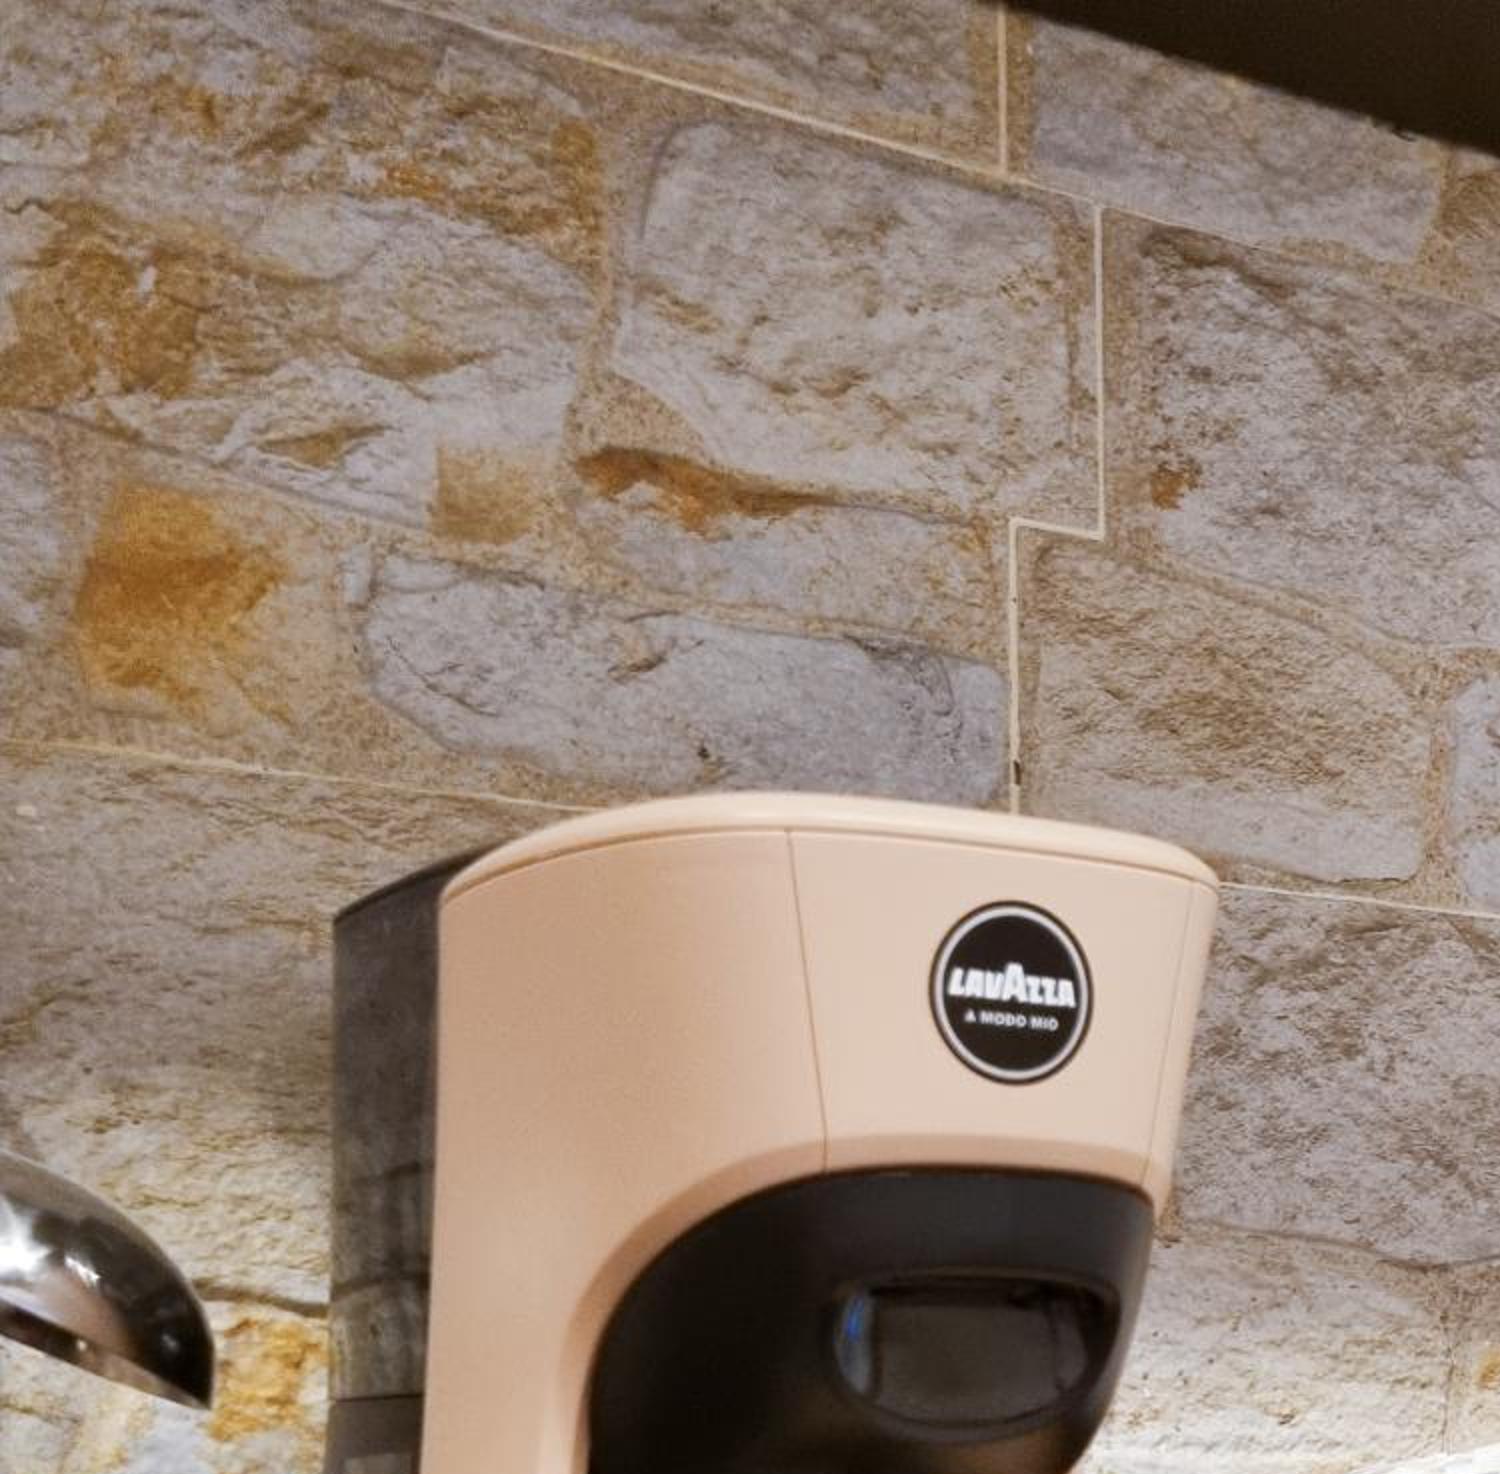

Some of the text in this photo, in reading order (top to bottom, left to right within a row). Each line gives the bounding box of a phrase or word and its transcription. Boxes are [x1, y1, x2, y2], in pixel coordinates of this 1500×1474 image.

[948, 962, 1076, 1008] LAVAZZA
[964, 1009, 1059, 1032] A MODO MIO
